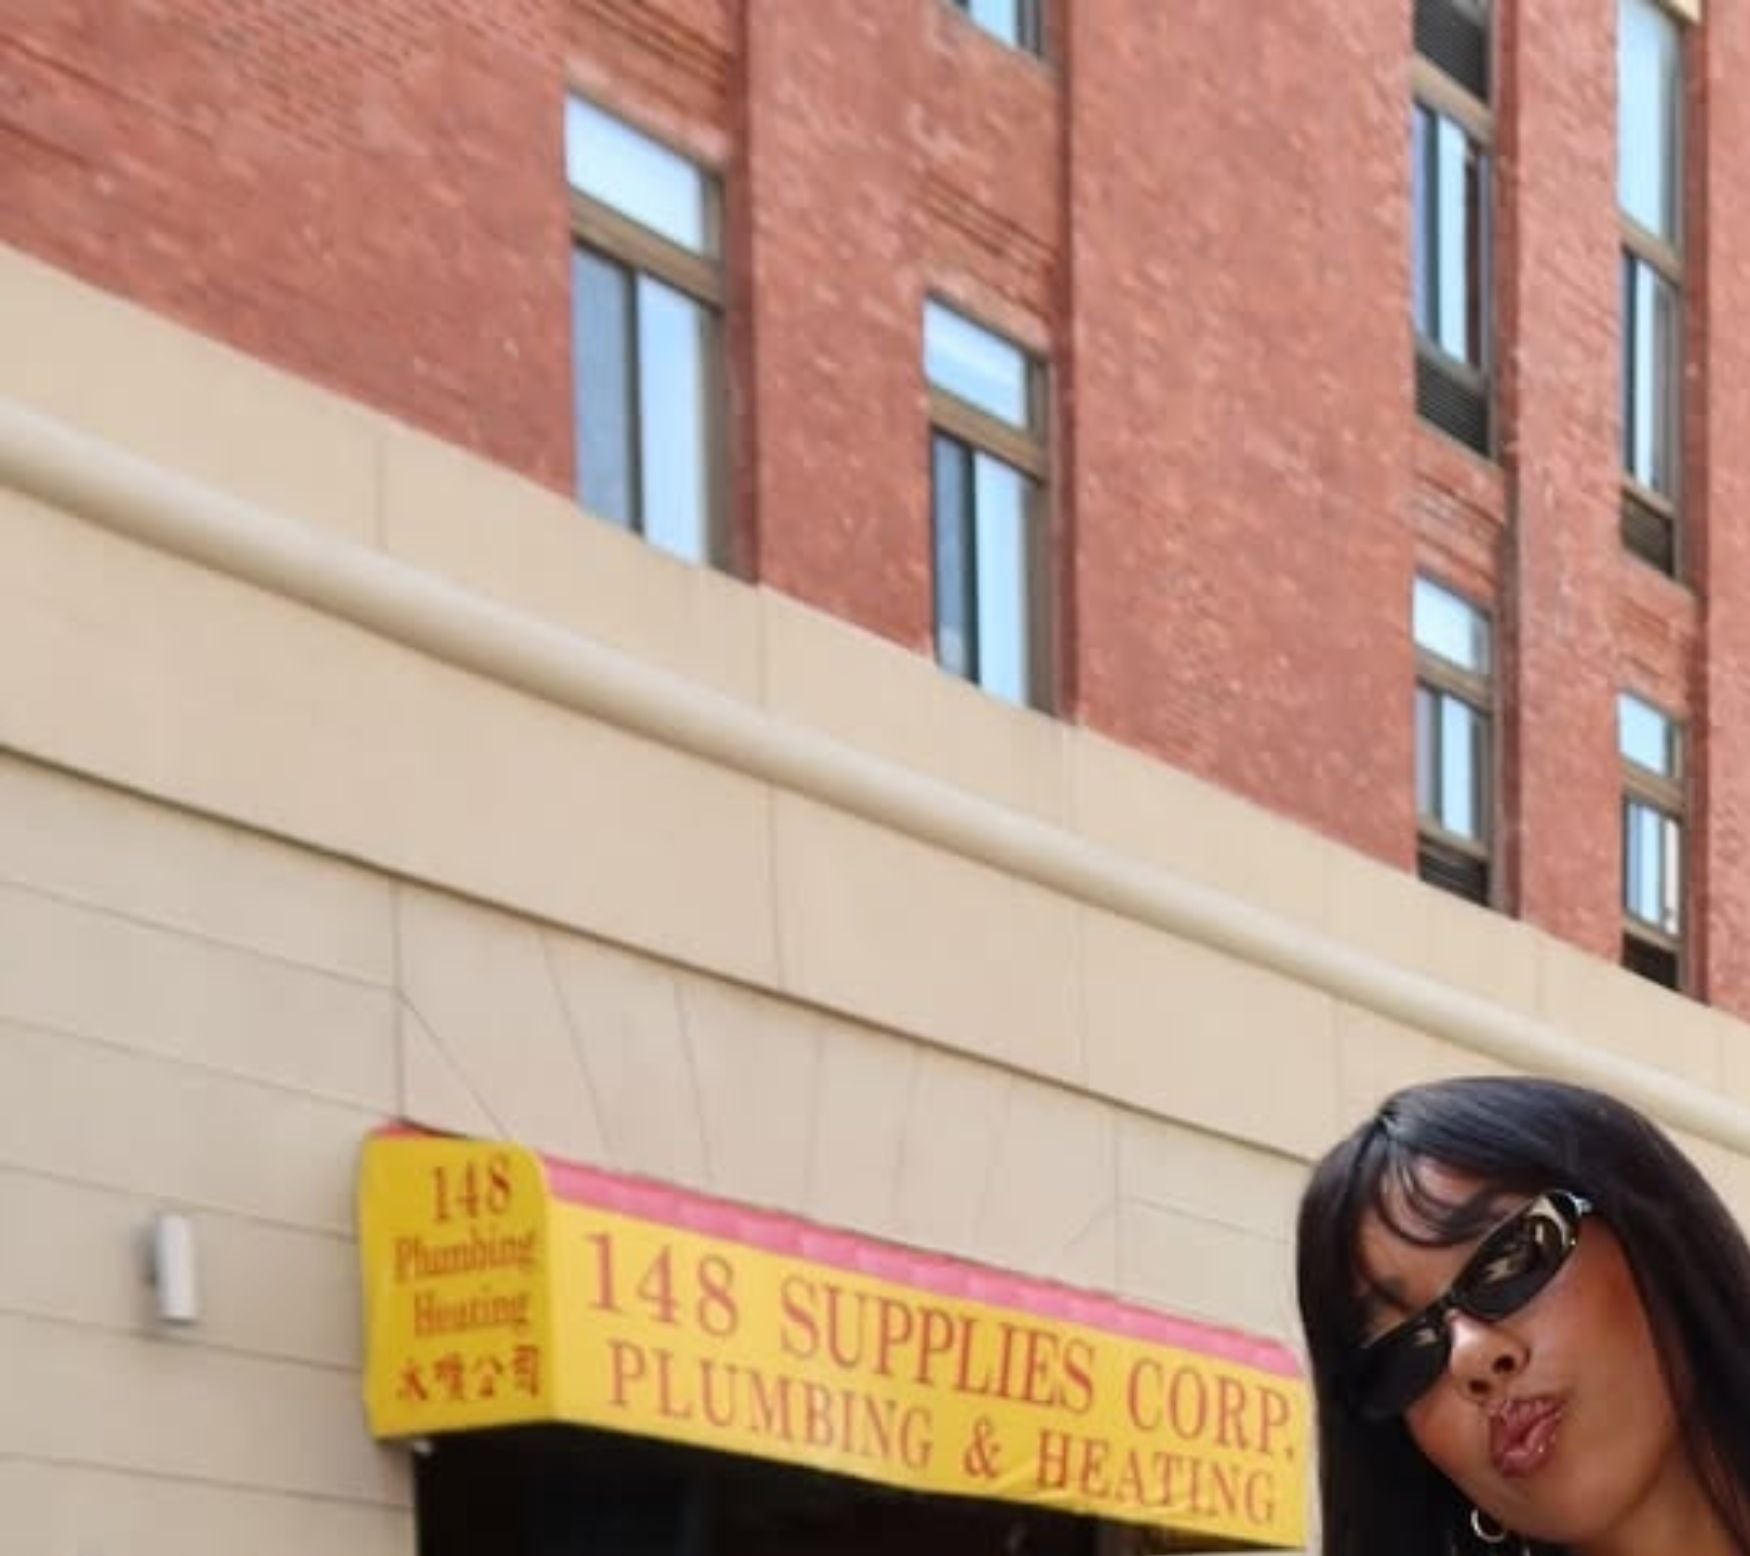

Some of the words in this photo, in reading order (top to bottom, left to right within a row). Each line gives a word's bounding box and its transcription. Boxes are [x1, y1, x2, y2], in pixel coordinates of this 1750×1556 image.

[432, 1152, 512, 1224] 148
[394, 1227, 537, 1284] Plumbing
[414, 1283, 530, 1338] Heating
[585, 1231, 739, 1338] 148
[779, 1274, 1096, 1416] SUPPLIES
[1126, 1356, 1295, 1460] CORP.
[607, 1338, 934, 1471] PLUMBING
[963, 1415, 1001, 1480] &
[1035, 1428, 1275, 1526] HEATING
